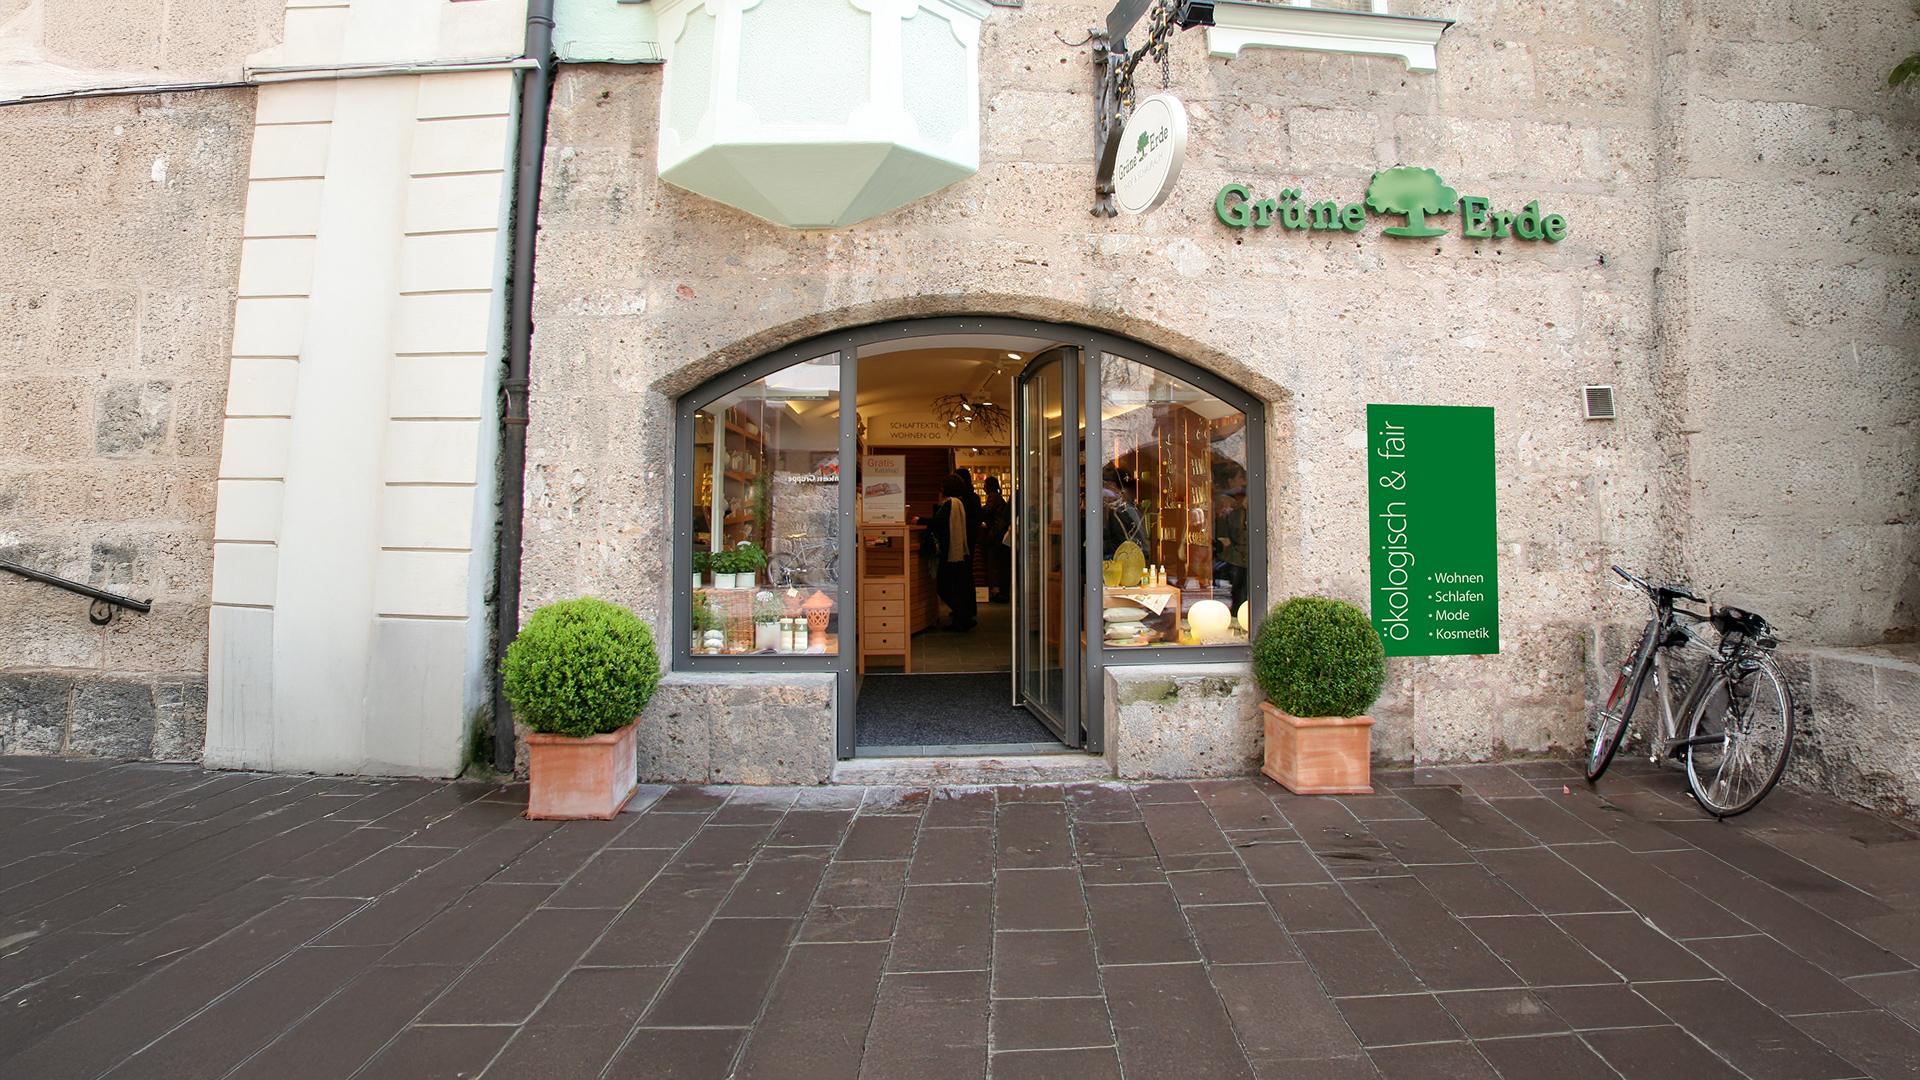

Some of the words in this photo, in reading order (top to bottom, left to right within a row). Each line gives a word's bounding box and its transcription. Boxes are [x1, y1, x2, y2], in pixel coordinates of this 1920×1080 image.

[1118, 156, 1138, 180] Grüne
[1149, 125, 1168, 152] Erde
[1214, 183, 1366, 232] Grüne
[1458, 196, 1568, 243] Erde
[889, 421, 941, 430] SCHLAFTEXTIL
[889, 431, 927, 440] WOHNEN
[928, 431, 941, 440] OG
[1377, 420, 1406, 460] fair
[867, 457, 895, 468] Gratis
[1379, 470, 1406, 491] &
[1379, 502, 1415, 641] ökologisch
[1434, 572, 1484, 583] Wohnen
[1435, 590, 1484, 603] Schlafen
[1436, 609, 1470, 621] Mode
[1436, 627, 1490, 640] Kosmetik
